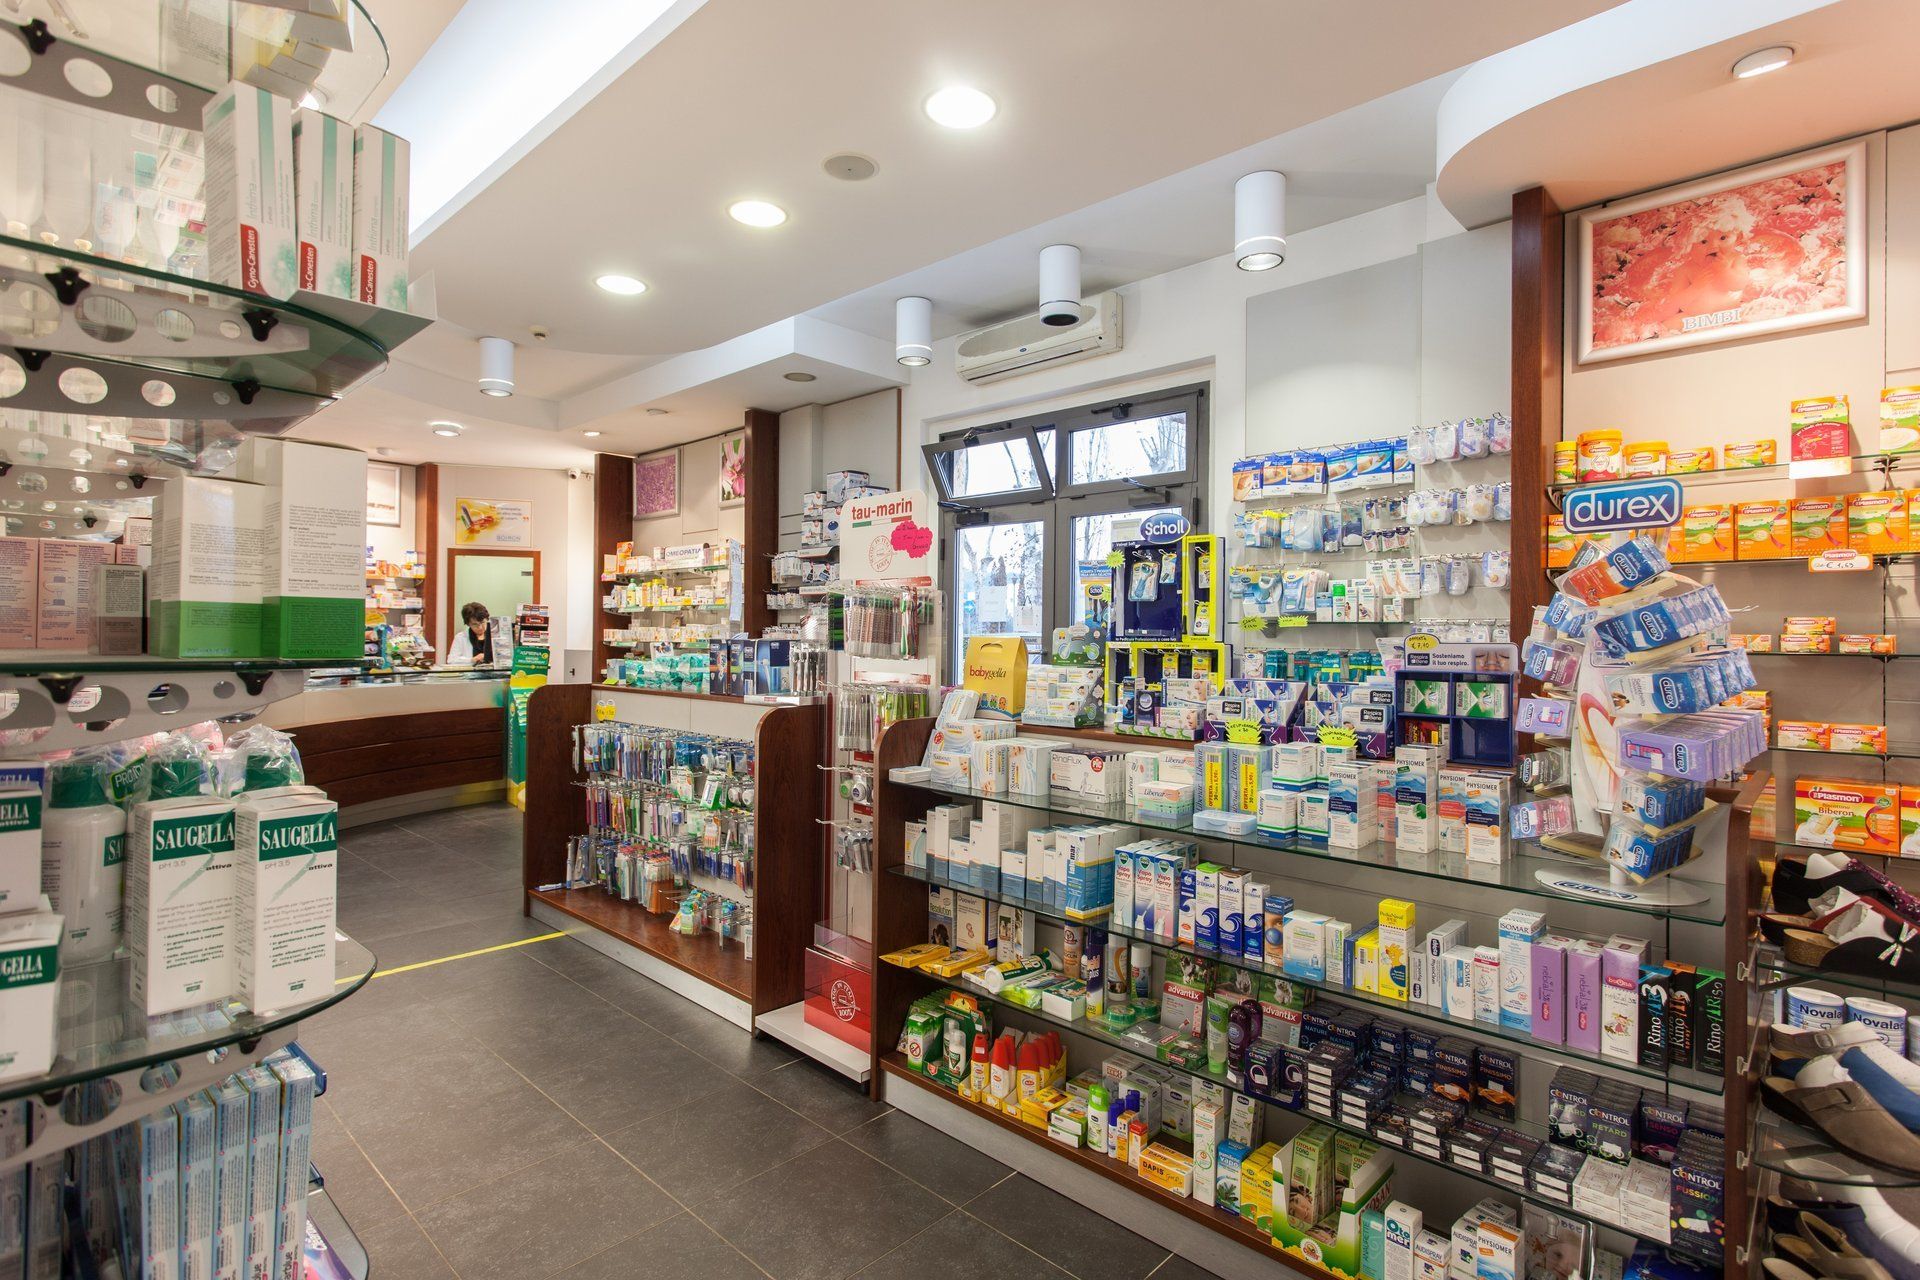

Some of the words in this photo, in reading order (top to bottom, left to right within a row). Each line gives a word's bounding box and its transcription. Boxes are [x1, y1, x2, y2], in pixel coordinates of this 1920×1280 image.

[248, 229, 257, 289] Gyno-Canesten
[1681, 310, 1742, 331] BIMBI
[851, 498, 913, 520] tau-marin
[1574, 492, 1671, 524] durex
[1144, 519, 1185, 536] Scholl
[1616, 554, 1637, 580] durex
[1641, 613, 1662, 640] durex
[1535, 651, 1547, 675] durex
[969, 665, 1007, 680] babygella
[1661, 679, 1676, 707] durex
[1396, 759, 1425, 767] PHYSIOMER
[1676, 744, 1687, 773] durex
[1329, 771, 1356, 780] PHYSIOMER
[1466, 782, 1498, 791] PHYSIOMER
[1817, 791, 1860, 804] Plasmon
[1818, 807, 1855, 817] Biberon
[155, 822, 236, 851] SAUGELLA
[261, 821, 336, 851] SAUGELLA
[206, 863, 232, 871] attiva
[308, 863, 334, 871] attiva
[1116, 870, 1131, 879] Spray
[1137, 874, 1152, 883] Spray
[1156, 879, 1171, 888] Spray
[1500, 923, 1529, 934] ISOMAR
[1168, 985, 1200, 1001] advantix
[1800, 1004, 1842, 1019] Novala
[1303, 1013, 1328, 1026] CONTRO
[1328, 1024, 1357, 1038] CONTROL
[1375, 1029, 1396, 1038] CONTROL
[1410, 1033, 1432, 1044] CONTROL
[1434, 1051, 1467, 1066] CONTROL
[1479, 1053, 1512, 1069] CONTROL
[1435, 1063, 1467, 1077] FINISSIMO
[1480, 1066, 1513, 1080] FINISSIMO
[1550, 1088, 1588, 1106] CONTROL
[1588, 1107, 1630, 1127] CONTROL
[1642, 1106, 1685, 1124] CONTROL
[1592, 1122, 1627, 1138] RETARD
[1295, 1140, 1316, 1152] OTOSAN
[1336, 1138, 1357, 1150] OTOSAN
[1142, 1161, 1165, 1176] DAPIS
[1672, 1166, 1721, 1190] CONTROL
[1387, 1217, 1410, 1240] Oto
[1478, 1235, 1513, 1256] PHYSIOMER
